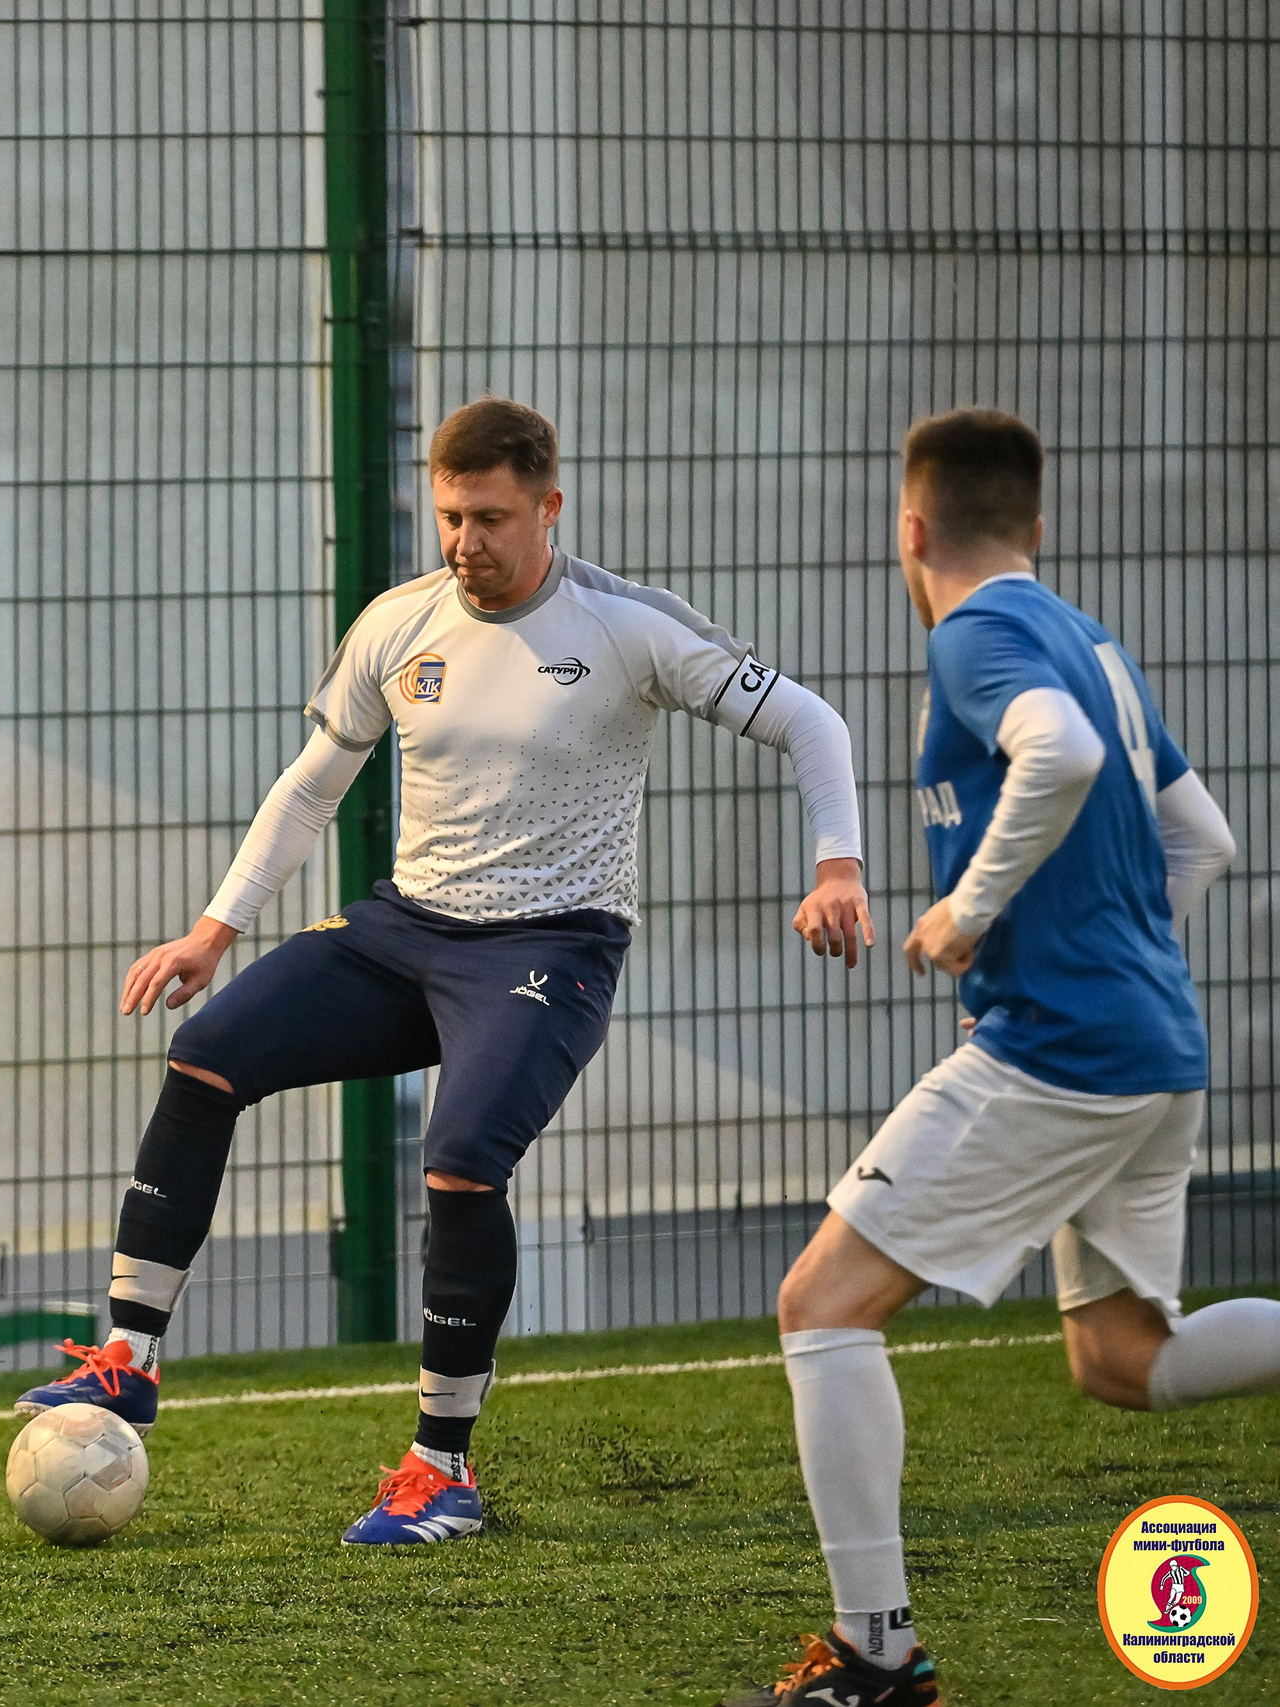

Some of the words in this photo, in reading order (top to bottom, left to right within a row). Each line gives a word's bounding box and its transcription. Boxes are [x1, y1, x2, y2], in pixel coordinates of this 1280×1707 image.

[537, 666, 578, 675] САТУРН
[1093, 641, 1157, 817] 4
[509, 985, 550, 1006] JÖGEL
[869, 1612, 883, 1656] DESIGN
